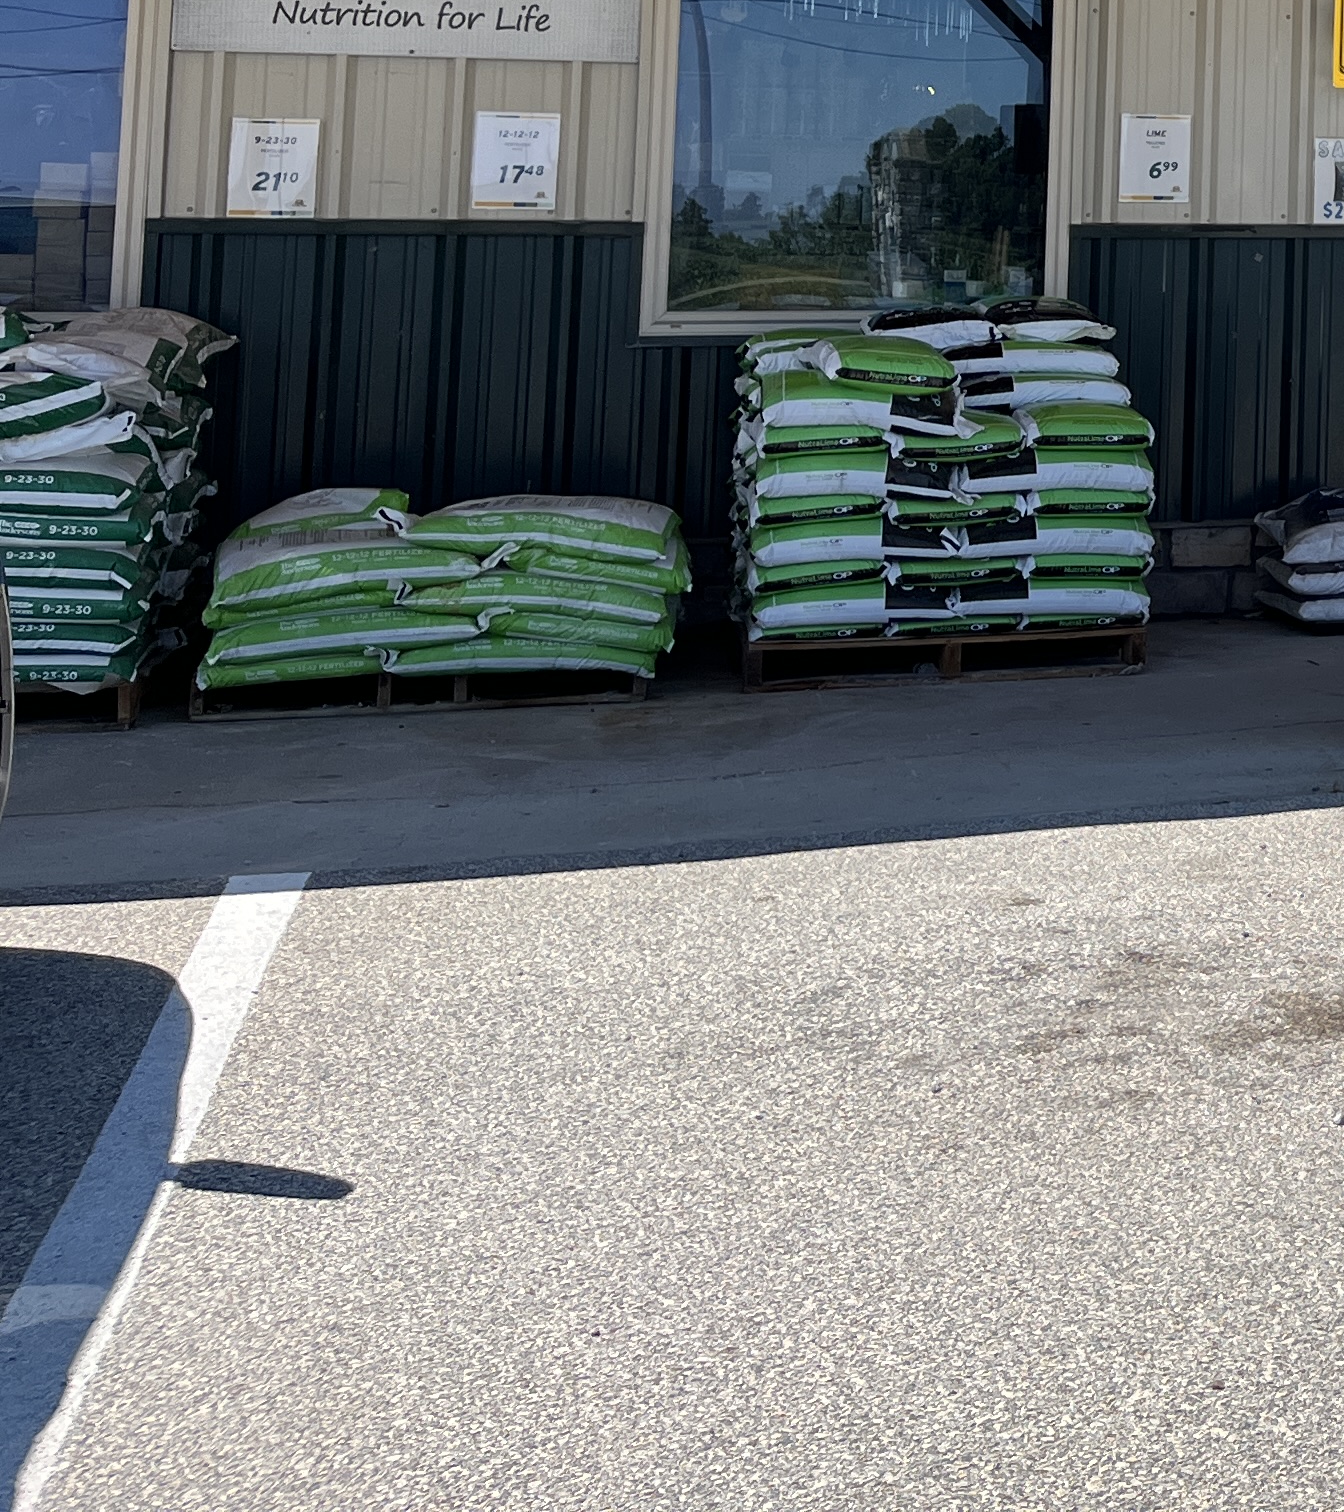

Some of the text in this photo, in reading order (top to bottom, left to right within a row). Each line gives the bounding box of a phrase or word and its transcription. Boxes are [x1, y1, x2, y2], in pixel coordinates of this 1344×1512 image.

[271, 0, 551, 33] Nutrition for Life
[1146, 129, 1168, 138] LIME
[4, 473, 55, 484] 9-23-30
[49, 525, 98, 536] 9-23-30
[6, 551, 56, 560] 9-23-30
[42, 604, 92, 615] 9-23-30
[29, 670, 78, 681] 9-23-30
